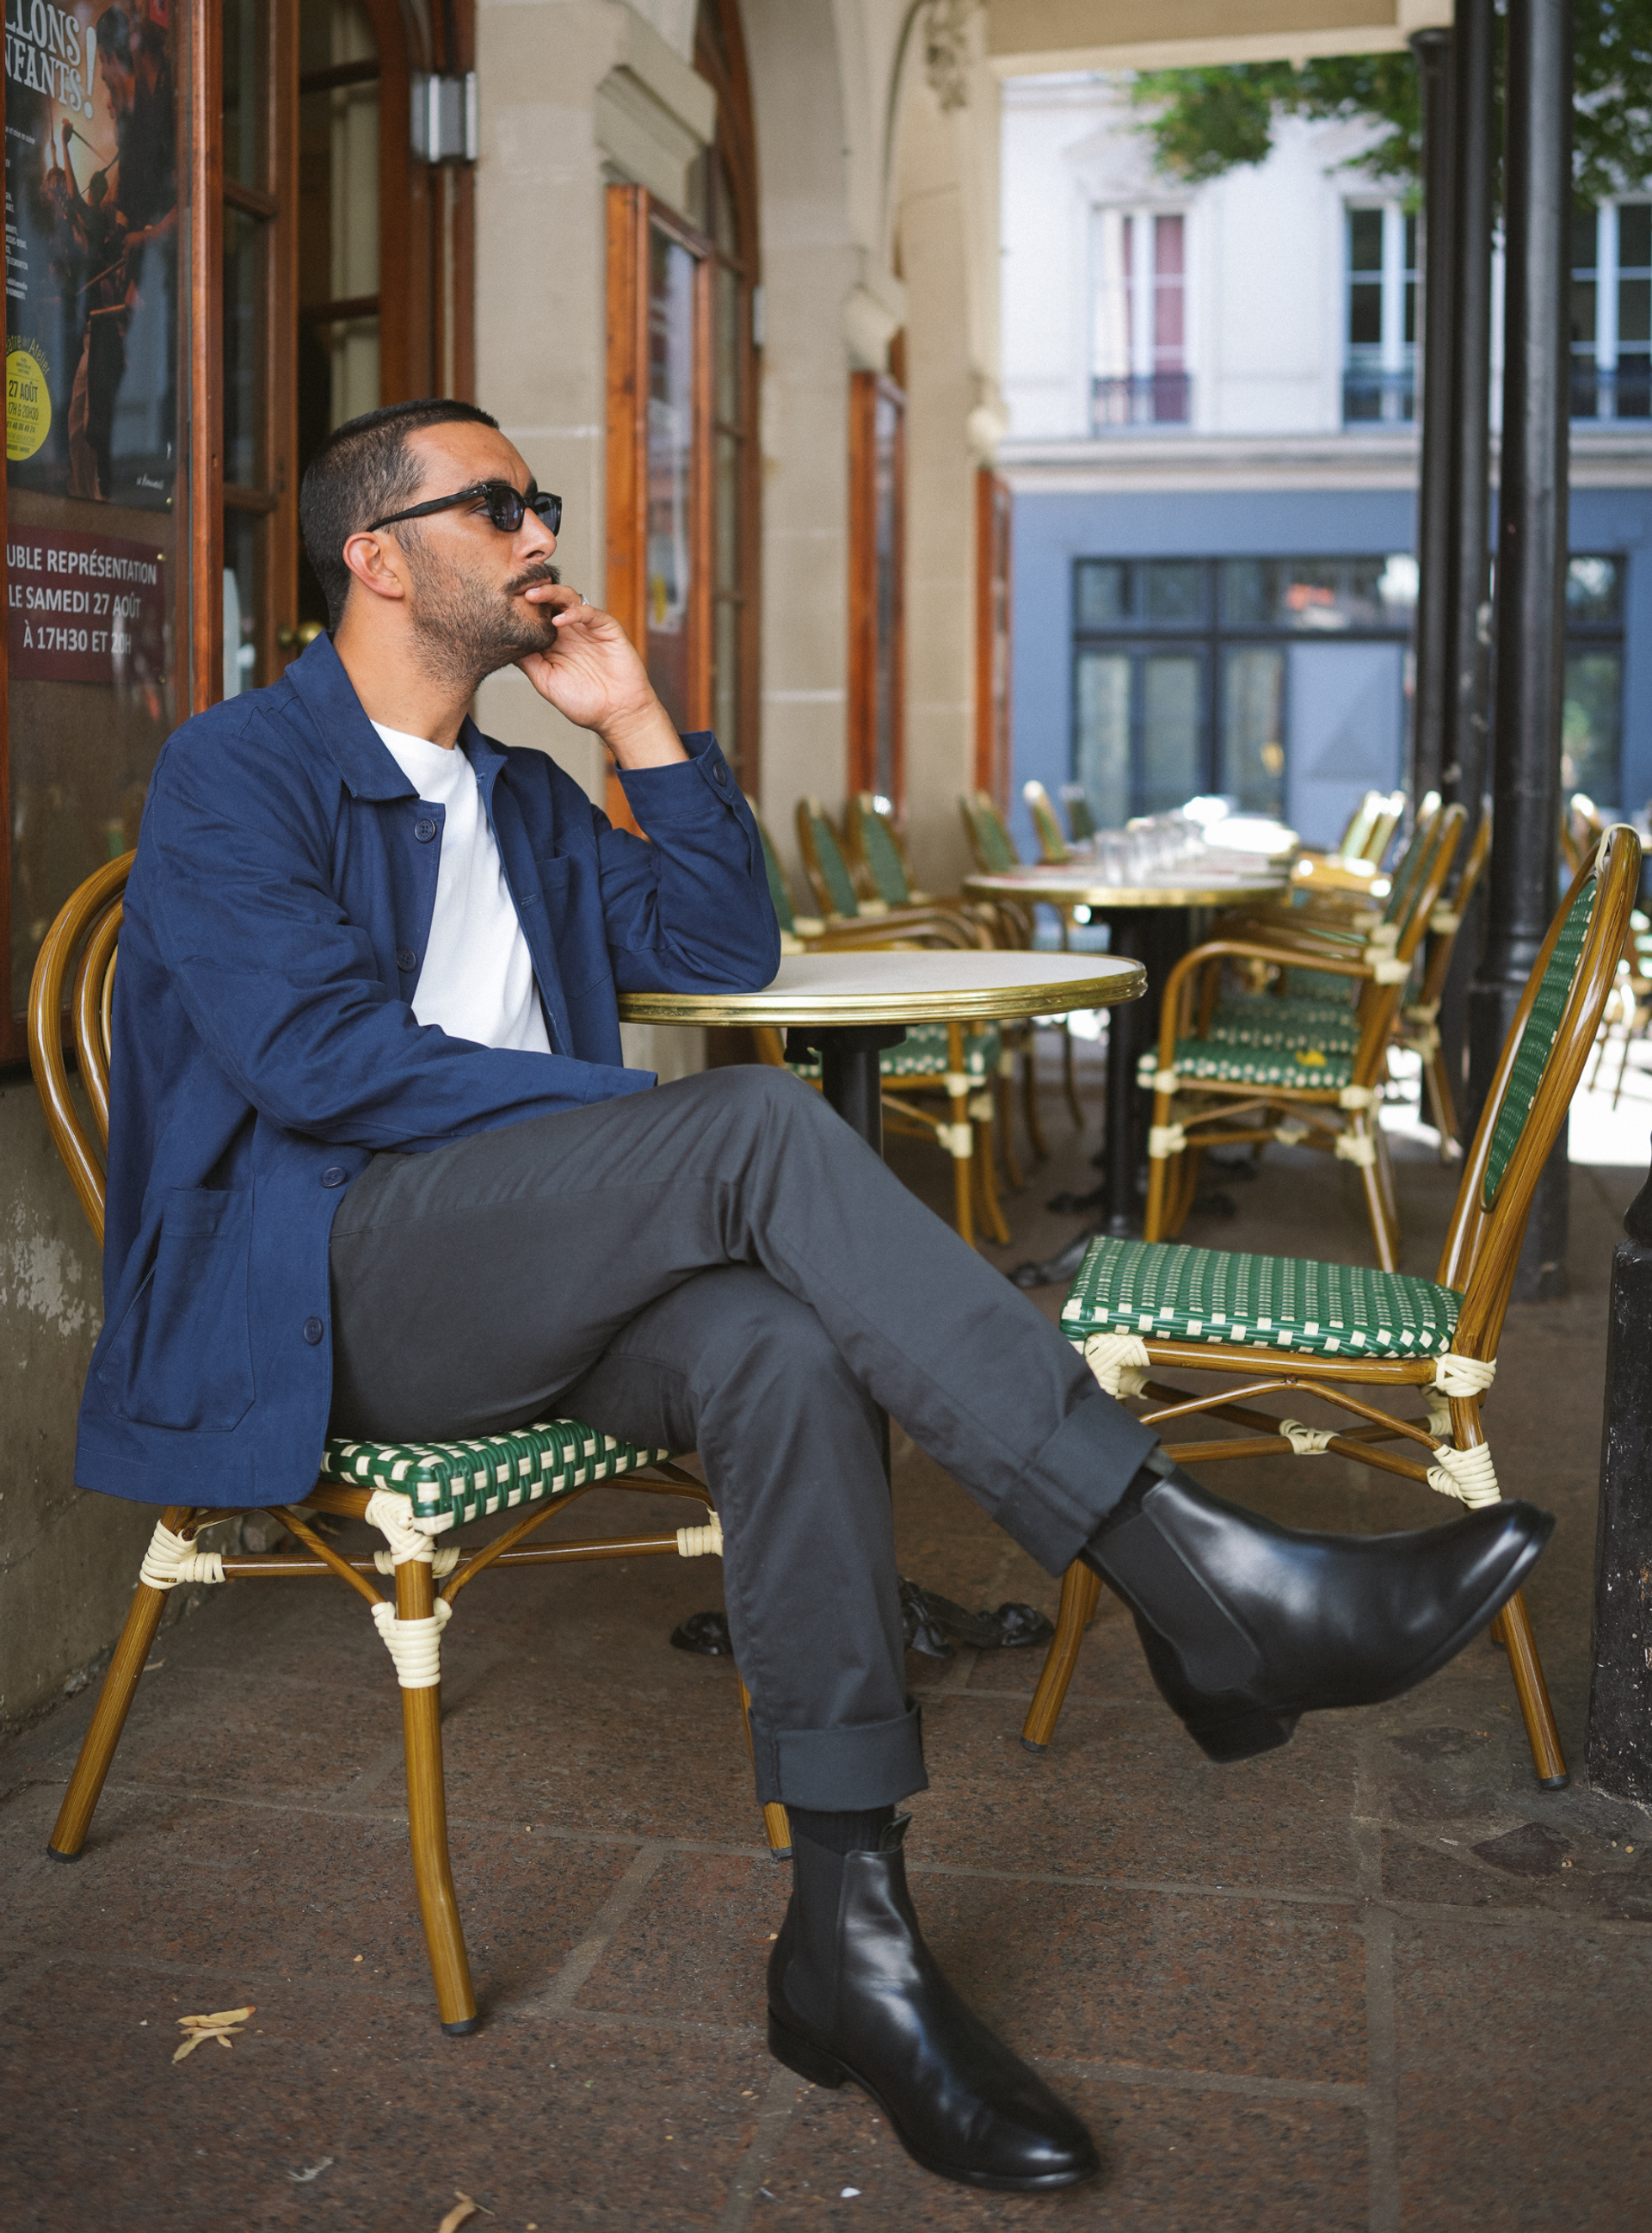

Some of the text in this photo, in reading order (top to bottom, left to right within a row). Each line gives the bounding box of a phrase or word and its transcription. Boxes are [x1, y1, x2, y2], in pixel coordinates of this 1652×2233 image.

[9, 379, 38, 403] 27 AOÛT
[8, 402, 17, 415] 17H
[22, 404, 40, 421] 20H30
[7, 544, 157, 586] UBLE REPRÉSENTATION
[9, 584, 141, 619] LE SAMEDI 27 AOÛT
[23, 620, 131, 654] À 17H30 ET 20H
